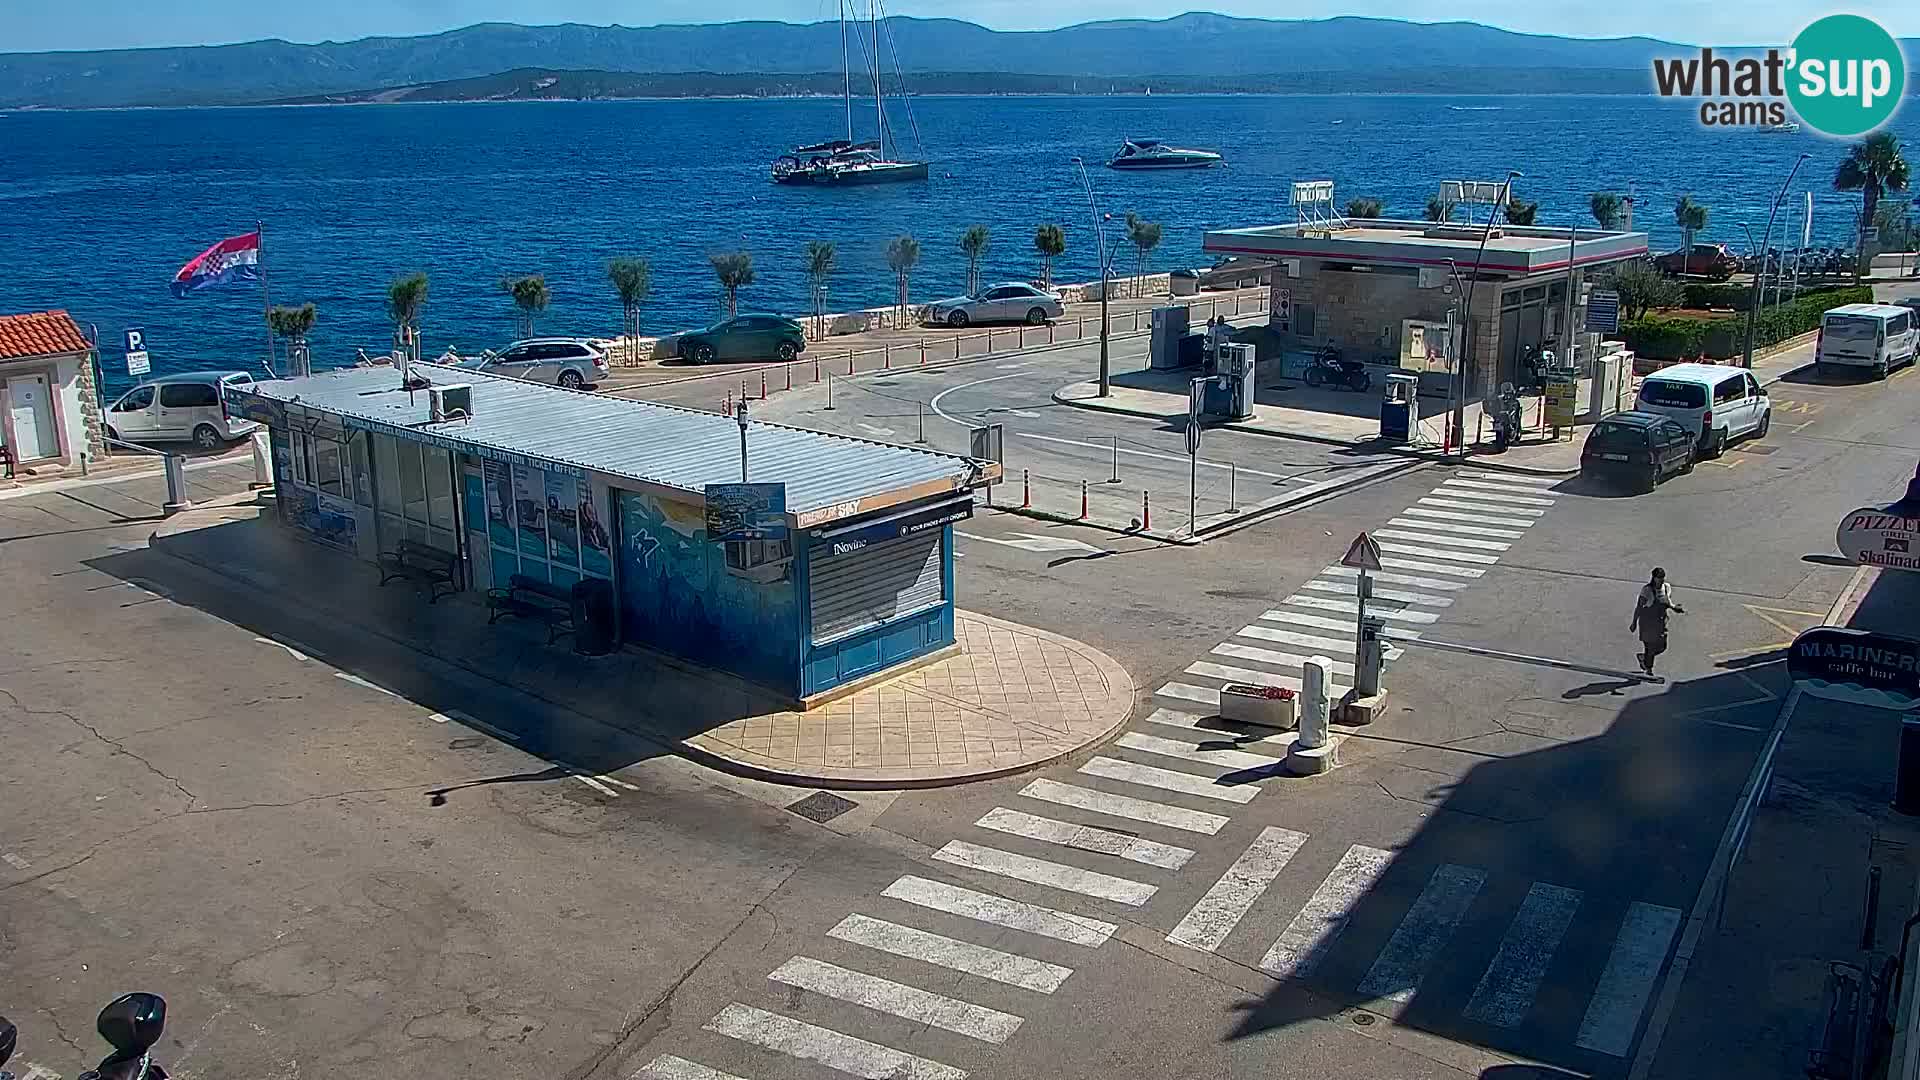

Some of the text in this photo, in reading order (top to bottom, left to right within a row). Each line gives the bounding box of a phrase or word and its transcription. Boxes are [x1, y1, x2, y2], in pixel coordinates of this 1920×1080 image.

[129, 332, 141, 349] P
[477, 447, 491, 458] BUS
[493, 451, 525, 465] STATION
[528, 458, 552, 471] TICKET
[554, 462, 581, 477] OFFICE
[1847, 515, 1920, 533] PIZZE
[1828, 663, 1896, 679] caffe bar
